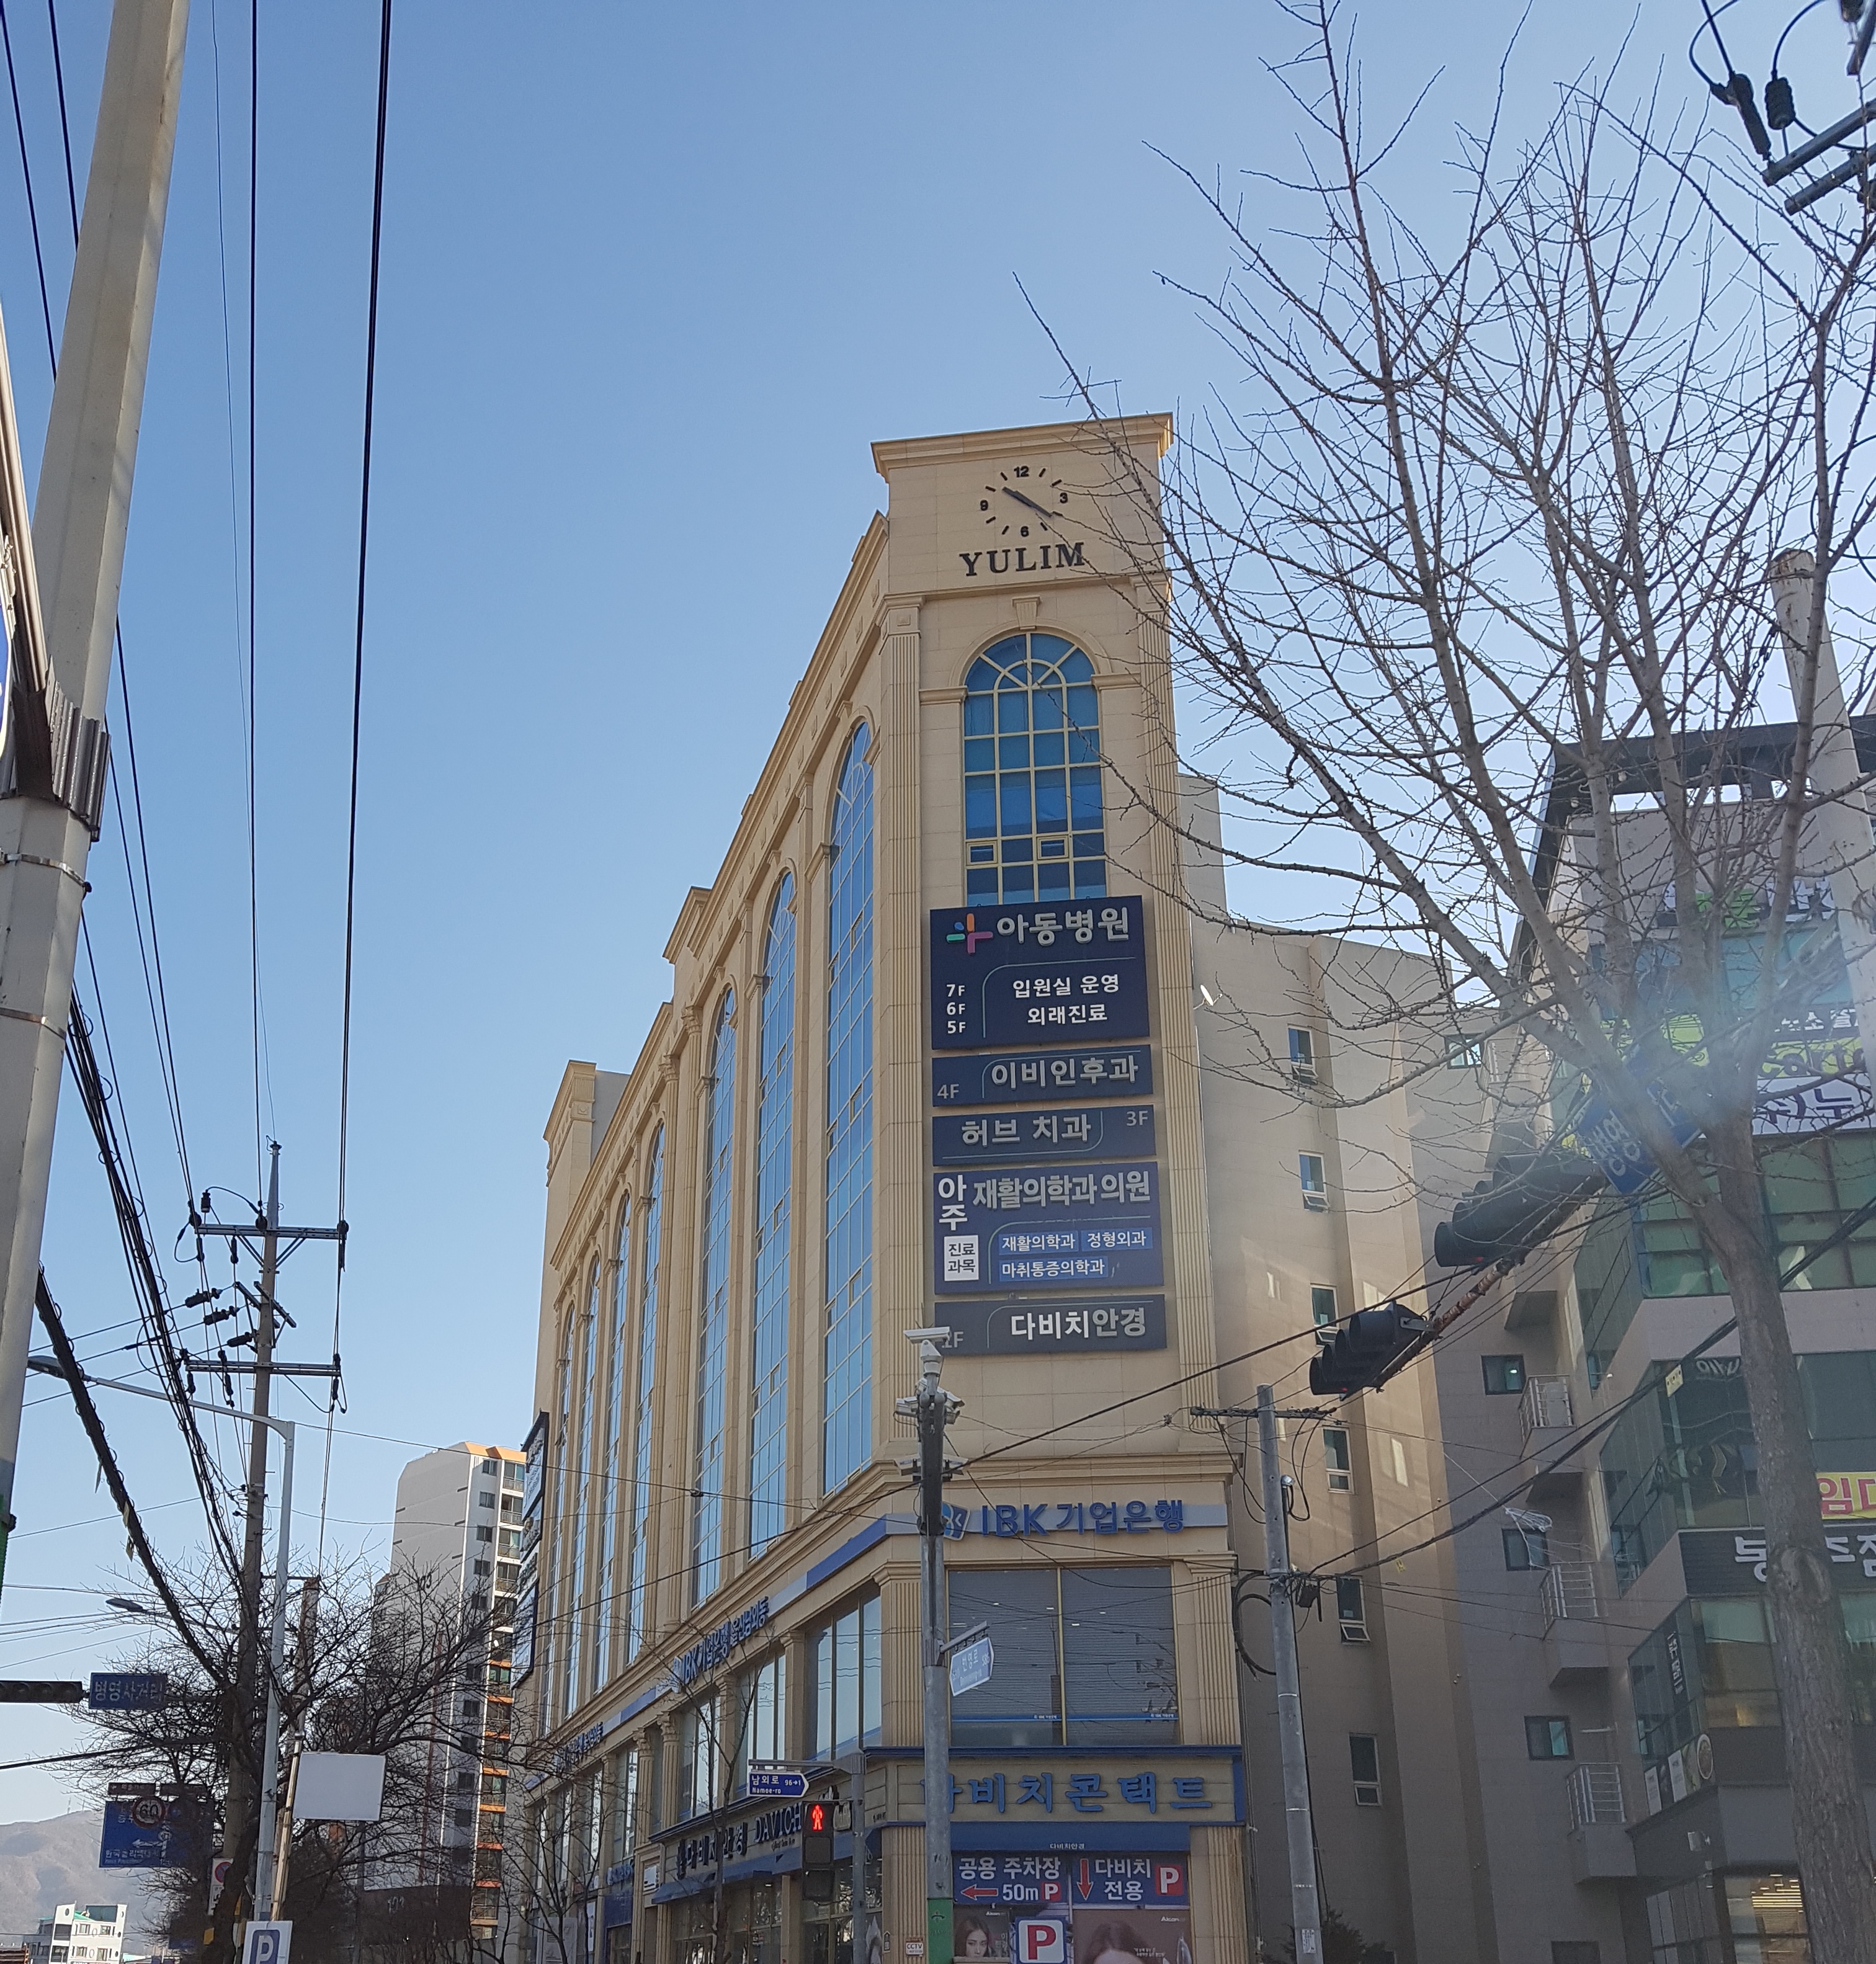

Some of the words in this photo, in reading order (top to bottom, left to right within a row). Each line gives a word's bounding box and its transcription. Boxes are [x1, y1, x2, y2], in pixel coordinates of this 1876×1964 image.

[1014, 466, 1029, 478] 12
[980, 499, 988, 511] 9
[1059, 493, 1068, 503] 3
[1020, 526, 1029, 537] 6
[959, 542, 1085, 576] YULIM
[996, 907, 1129, 947] 아동병원
[946, 984, 965, 998] 7F
[1012, 976, 1071, 999] 입원실
[1080, 974, 1120, 994] 운영
[946, 1002, 966, 1015] 6F
[1027, 1004, 1108, 1025] 외래진료
[947, 1020, 967, 1034] 5F
[991, 1055, 1138, 1090] 이비인후과
[937, 1083, 960, 1099] 4F
[1126, 1110, 1149, 1127] 3F
[961, 1118, 1021, 1148] 허브
[1032, 1114, 1092, 1144] 치과
[947, 1241, 976, 1257] 진료
[1002, 1233, 1076, 1252] 재활의학과
[1087, 1230, 1147, 1248] 정형외과
[947, 1258, 976, 1274] 과목
[1002, 1258, 1105, 1279] 마취통증의학과
[1011, 1306, 1146, 1341] 다비치안경
[751, 1775, 780, 1786] 남외로
[754, 1802, 802, 1843] DAVICH
[959, 1857, 997, 1880] 공용
[1003, 1857, 1061, 1880] 주차장
[1095, 1859, 1151, 1878] 다비치
[1159, 1867, 1179, 1893] P
[1002, 1883, 1039, 1901] 50m
[1044, 1883, 1059, 1900] P
[1104, 1881, 1144, 1901] 전용
[1027, 1924, 1056, 1960] P
